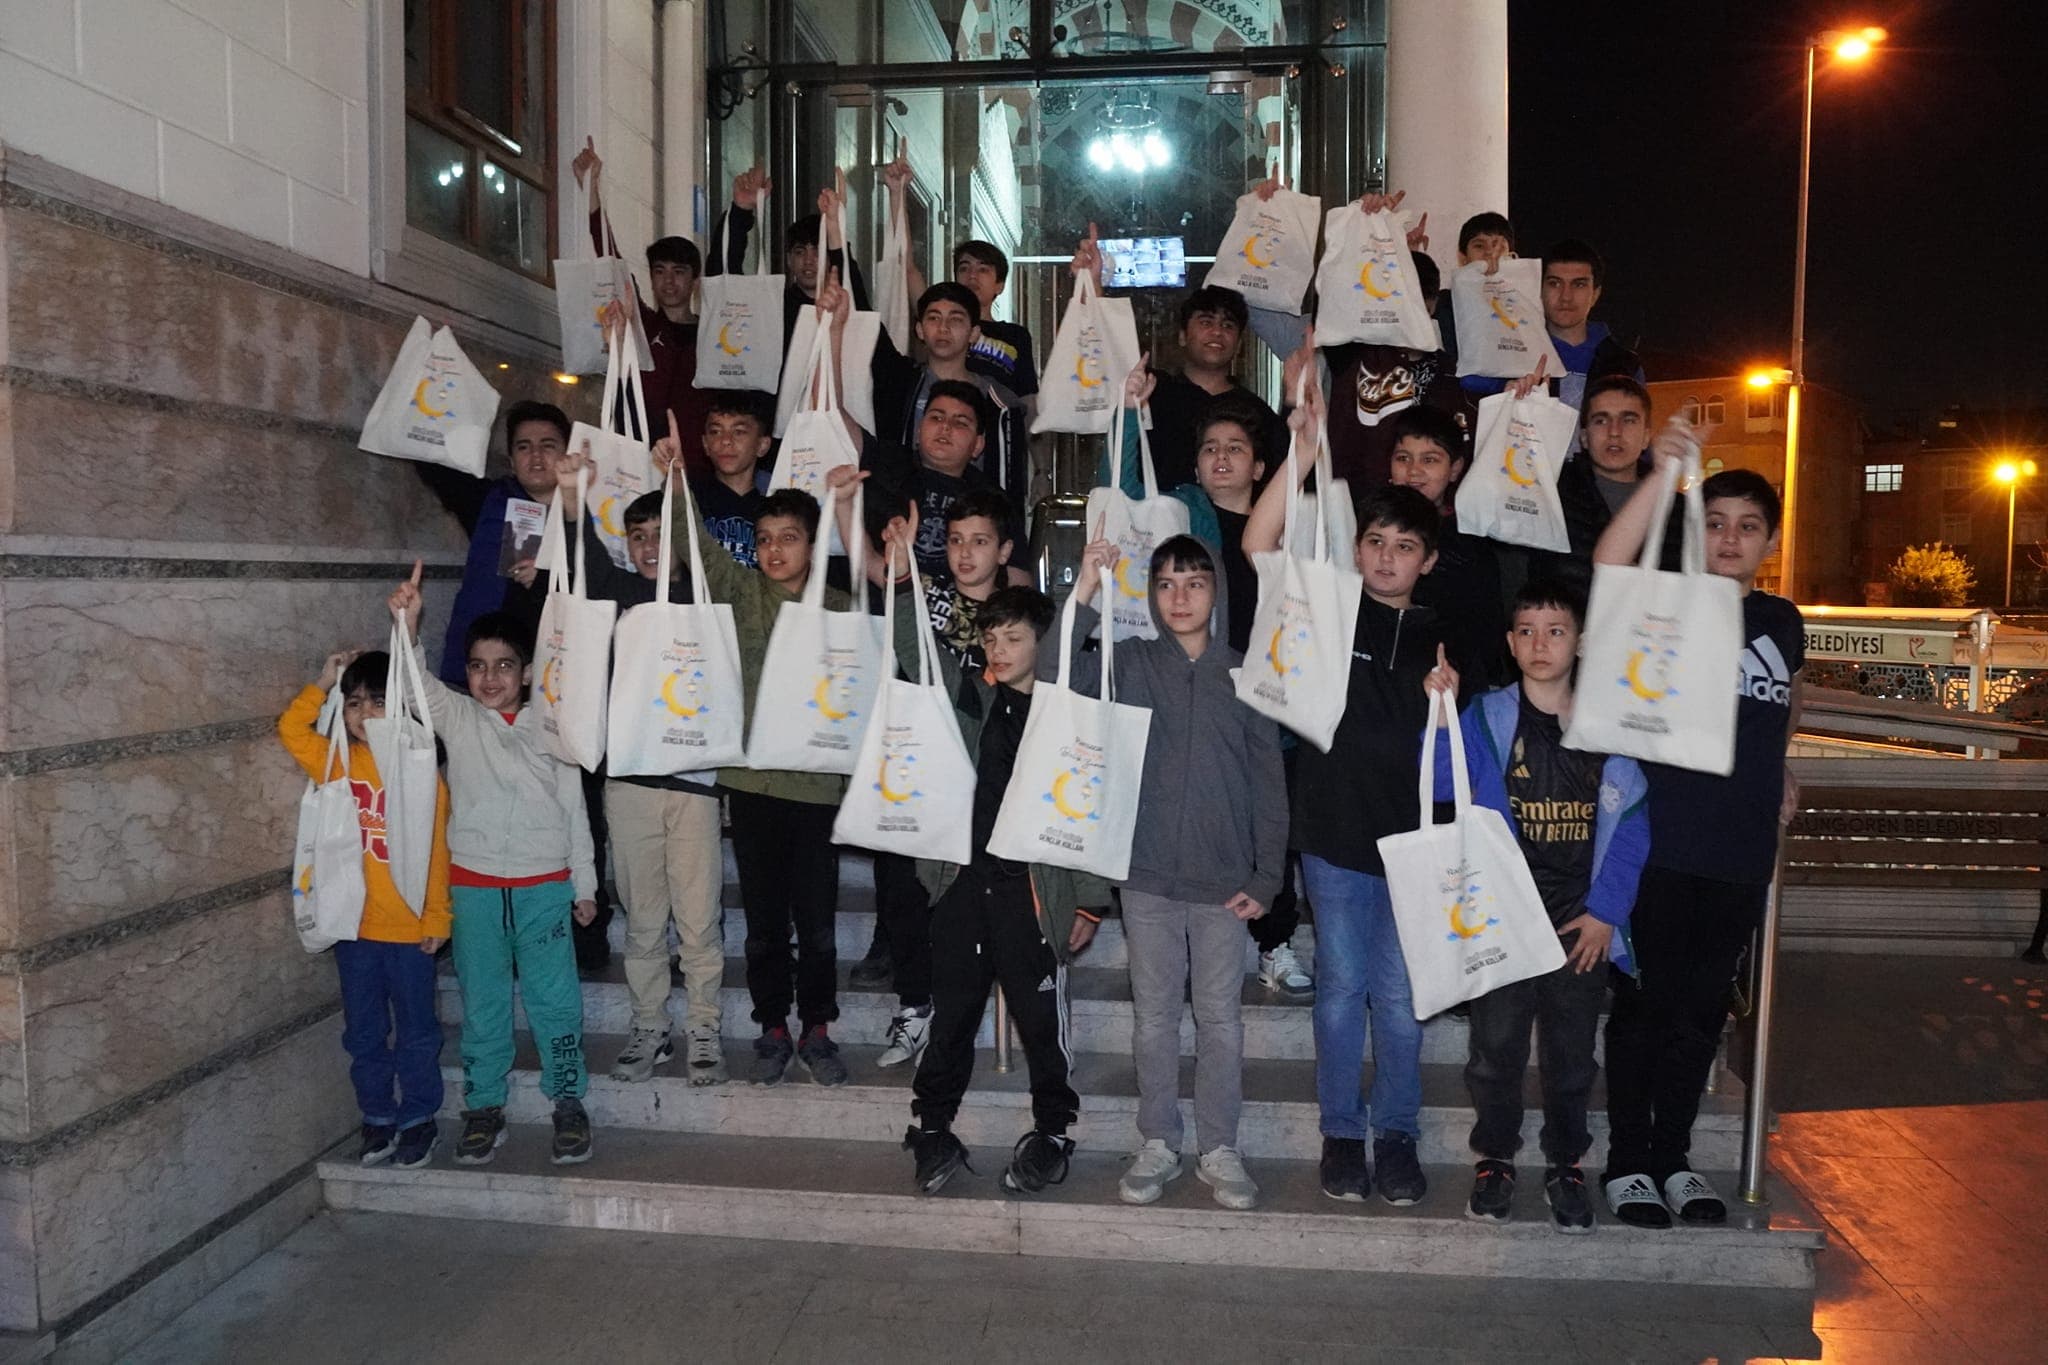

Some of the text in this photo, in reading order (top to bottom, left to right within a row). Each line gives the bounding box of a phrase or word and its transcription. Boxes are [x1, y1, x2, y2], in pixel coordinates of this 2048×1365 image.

[1802, 632, 1884, 655] BELEDİYESİ
[1522, 822, 1590, 843] FLY BETTER
